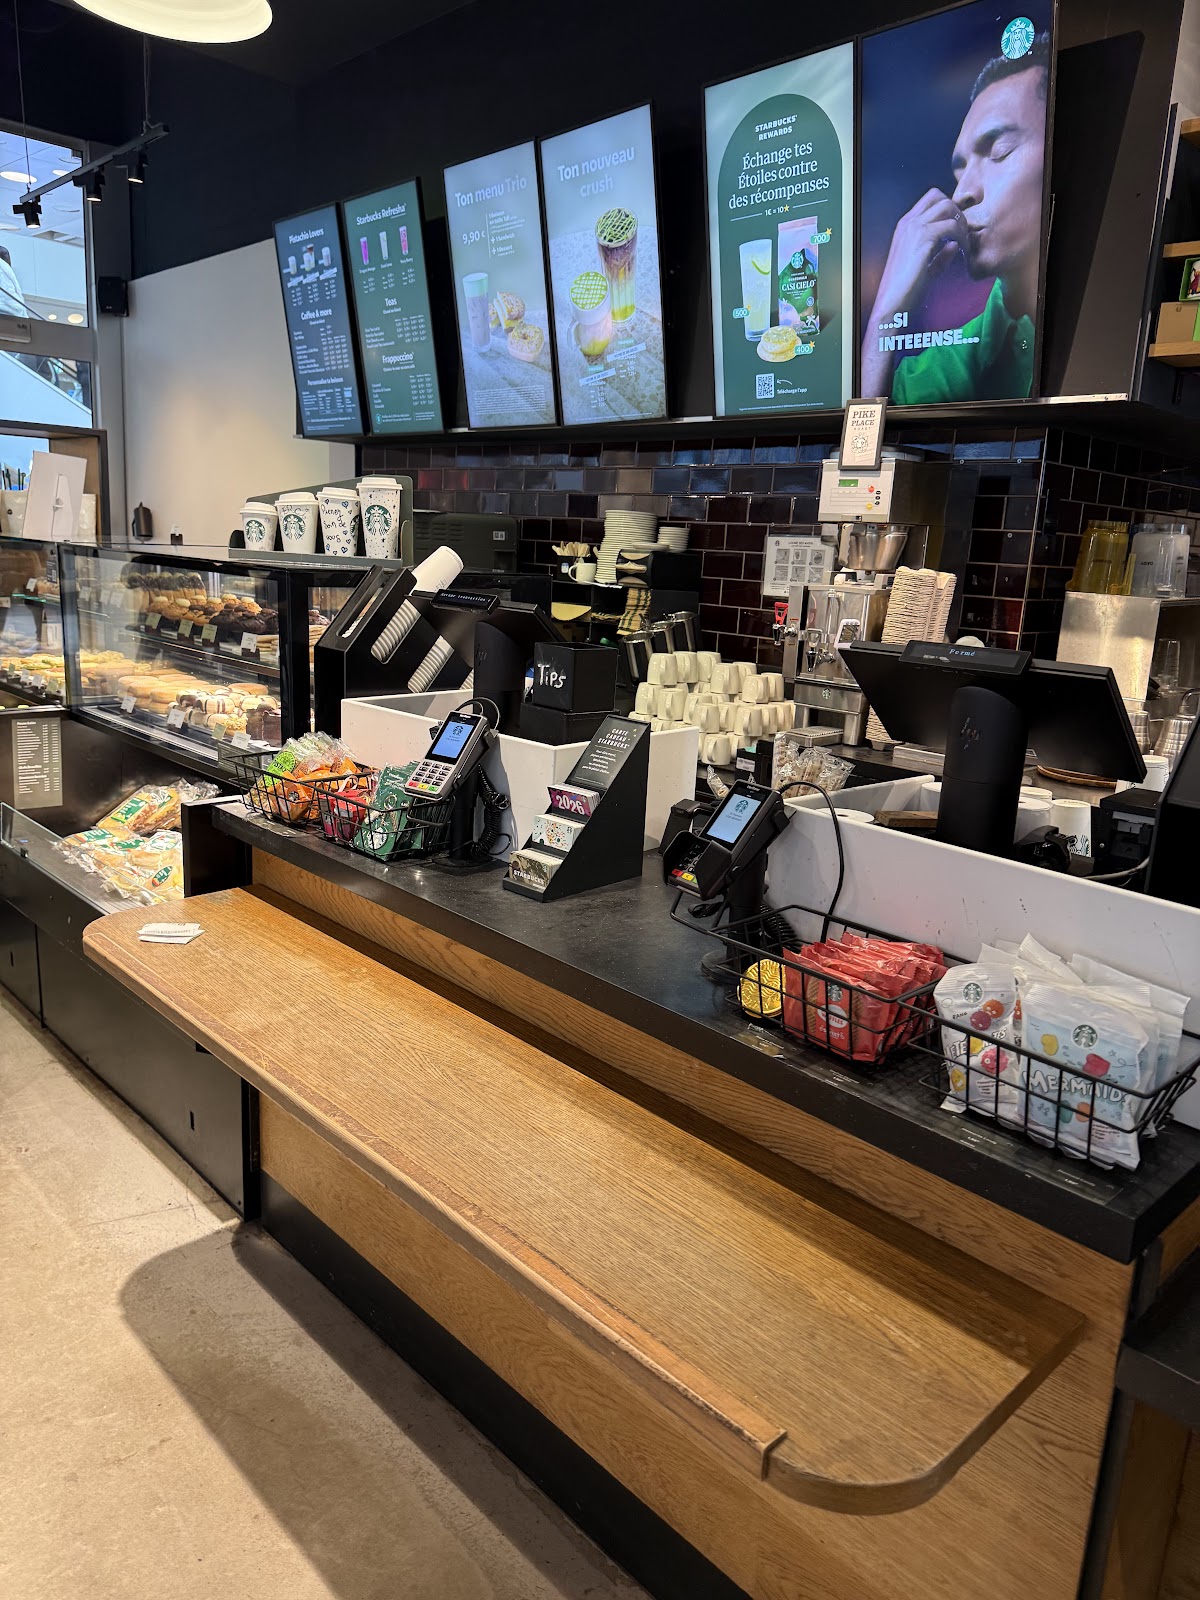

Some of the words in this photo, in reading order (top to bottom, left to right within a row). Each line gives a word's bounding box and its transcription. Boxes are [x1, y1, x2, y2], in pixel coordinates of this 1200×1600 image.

[755, 115, 796, 132] STARBUCKS
[758, 126, 793, 141] REWARDS
[743, 147, 792, 170] Échange
[794, 142, 813, 157] tes
[557, 164, 580, 182] Ton
[581, 146, 635, 175] nouveau
[738, 169, 777, 190] Étoiles
[779, 160, 818, 180] contre
[455, 192, 474, 207] Ton
[475, 183, 505, 202] menu
[505, 174, 527, 193] Trio
[580, 174, 614, 198] crush
[728, 193, 749, 210] des
[750, 176, 830, 205] récompenses
[356, 211, 381, 225] Starbucks
[288, 231, 309, 245] Pistachio
[309, 228, 324, 238] Lovers
[462, 230, 480, 245] 9,90
[813, 235, 827, 243] 700
[781, 282, 796, 292] CASI
[796, 280, 815, 290] CIELO
[385, 298, 397, 306] Teas
[301, 310, 316, 321] Coffee
[315, 309, 320, 318] &
[320, 308, 332, 317] more
[735, 309, 748, 317] 500
[878, 328, 980, 352] INTEEENSE...
[796, 345, 810, 353] 400
[382, 352, 414, 364] Frappuccino
[852, 410, 876, 419] PIKE
[851, 419, 875, 427] PLACE
[949, 648, 976, 657] Fermé
[537, 663, 567, 688] Tips
[605, 733, 627, 742] CADEAU
[611, 728, 629, 736] CARTE
[597, 738, 628, 749] STARBUCKS
[555, 794, 585, 815] 2026
[513, 869, 545, 886] STARBUCKS
